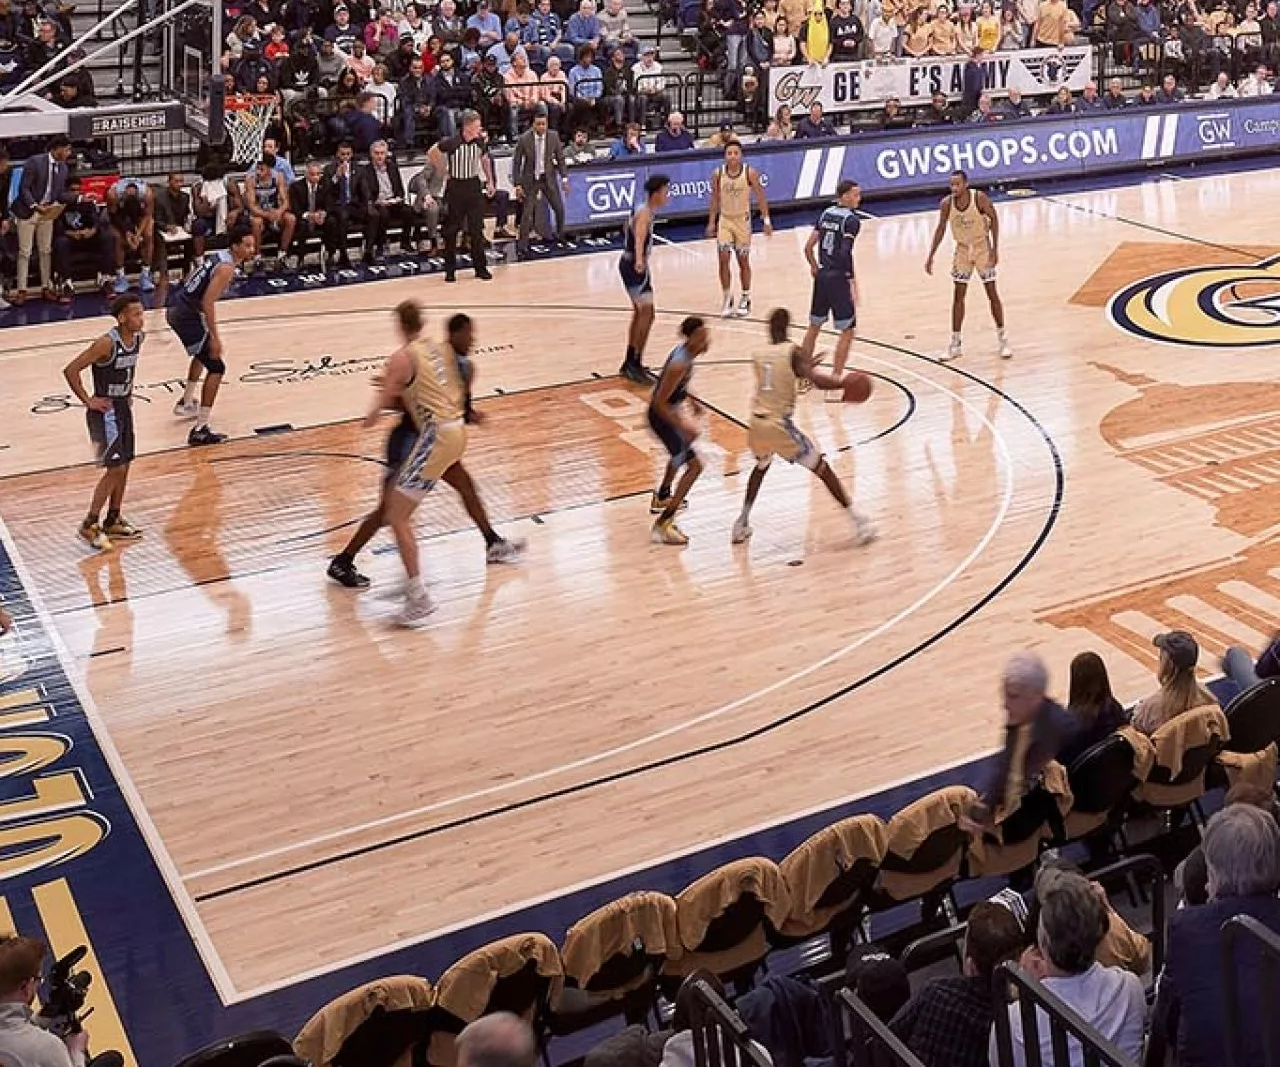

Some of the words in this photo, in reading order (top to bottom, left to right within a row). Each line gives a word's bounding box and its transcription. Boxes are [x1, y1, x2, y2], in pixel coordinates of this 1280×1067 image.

[775, 71, 822, 109] GW
[950, 60, 1011, 92] AMY
[876, 127, 1119, 180] GWSHOPS.COM
[1199, 119, 1231, 144] GW
[587, 180, 637, 211] GW
[822, 231, 836, 256] 4
[760, 363, 773, 391] 1
